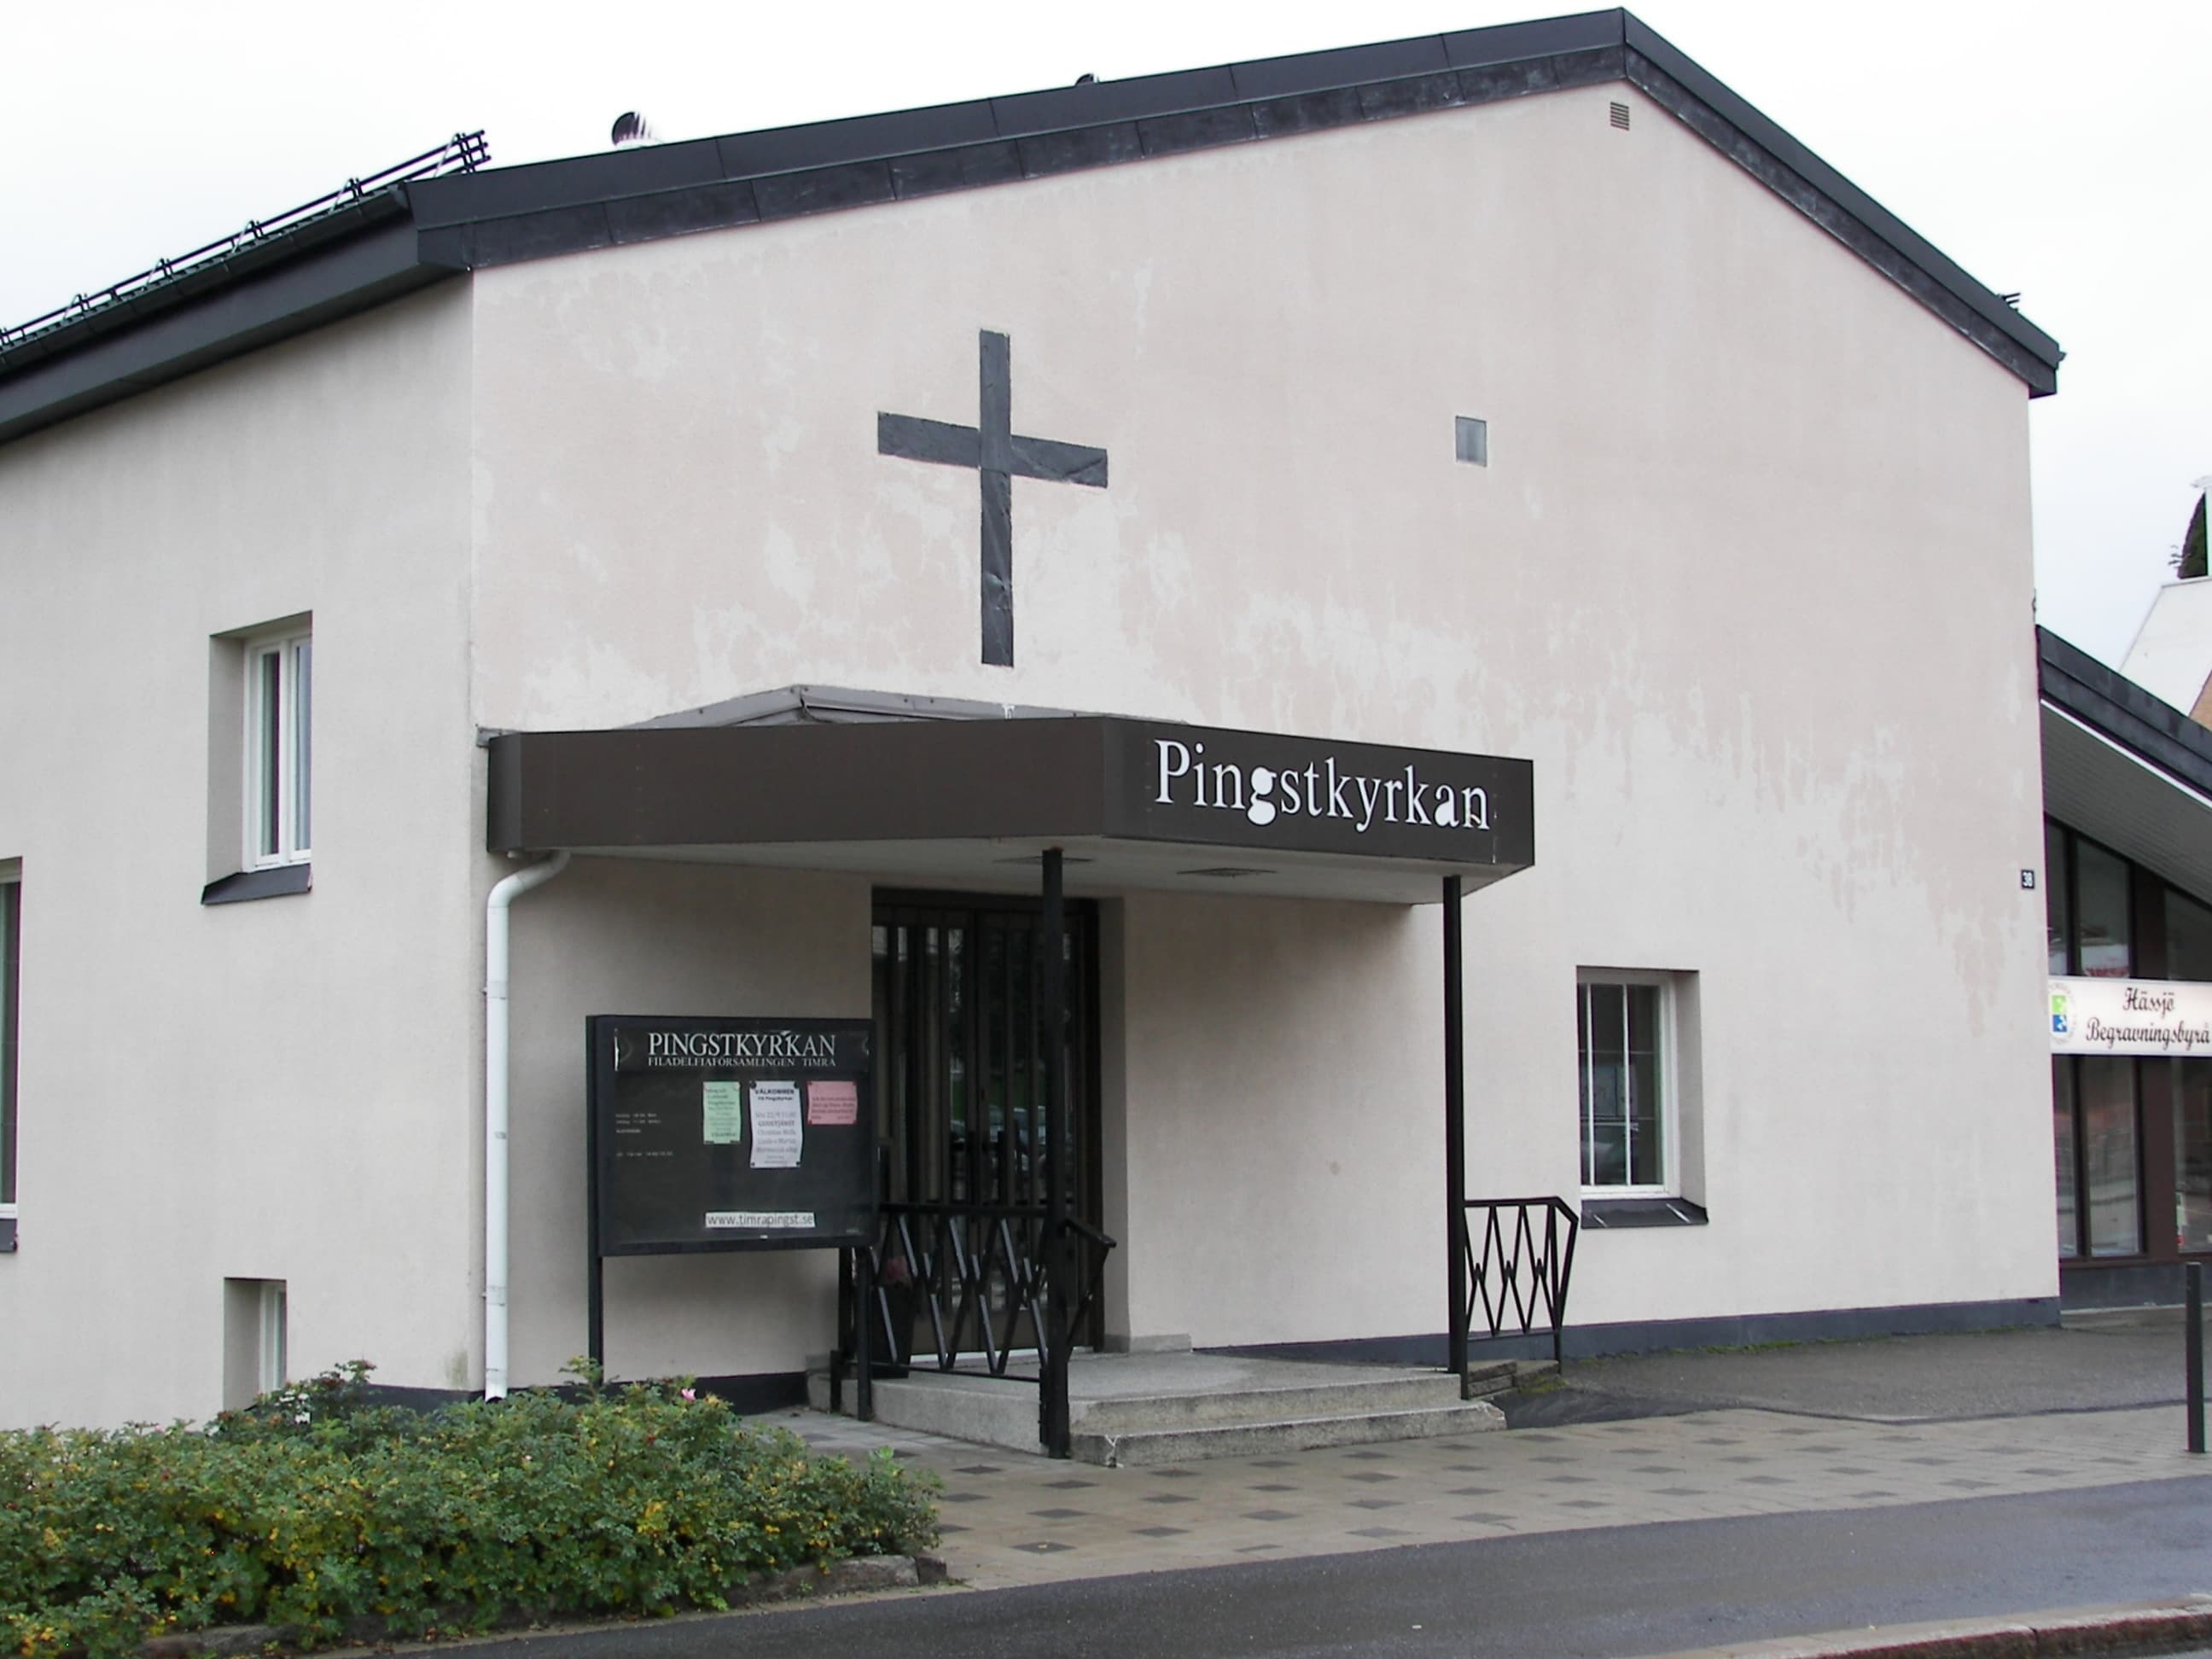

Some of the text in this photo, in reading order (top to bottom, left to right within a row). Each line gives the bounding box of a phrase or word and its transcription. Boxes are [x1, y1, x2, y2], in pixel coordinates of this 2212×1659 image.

[1154, 739, 1490, 833] Pingstkyrkan
[2122, 987, 2174, 1019] Hässjö
[649, 1032, 835, 1057] PINGSTKYRKAN
[2086, 1016, 2210, 1051] Begravningsbyrå
